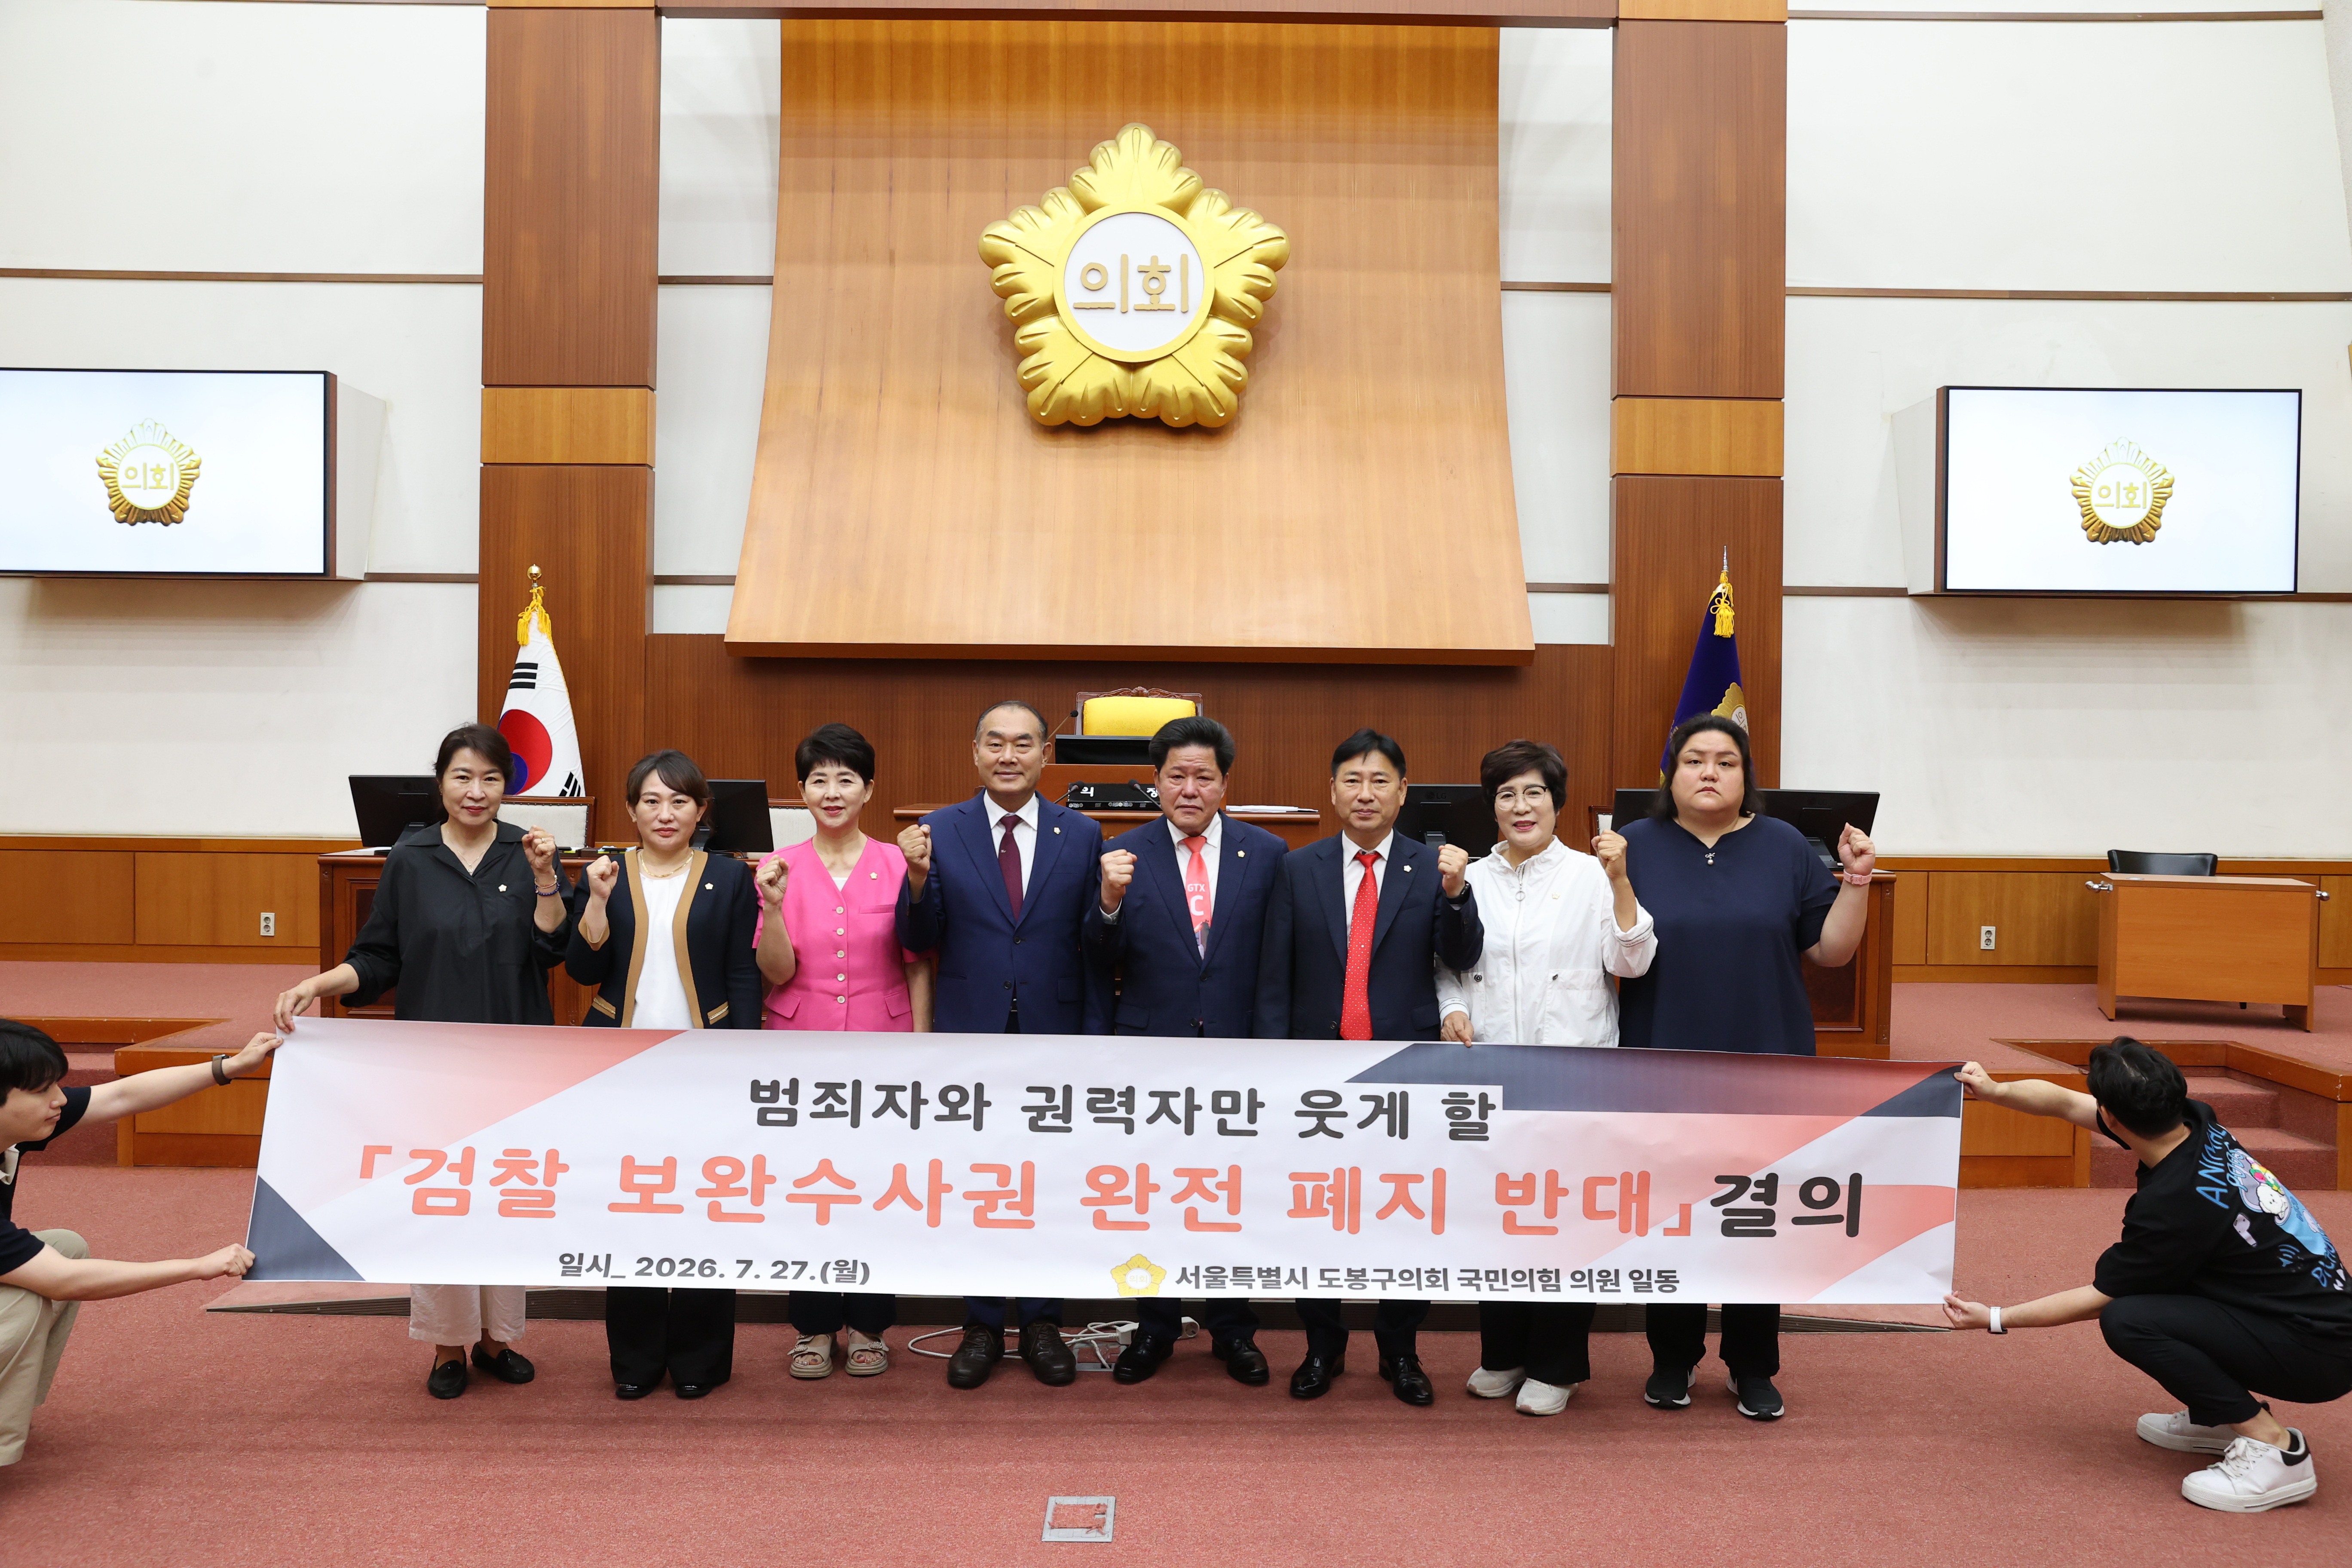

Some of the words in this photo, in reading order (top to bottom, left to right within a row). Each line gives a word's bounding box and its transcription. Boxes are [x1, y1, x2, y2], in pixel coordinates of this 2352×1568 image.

[1073, 254, 1188, 313] 의회
[121, 462, 174, 490] 의회
[2094, 481, 2147, 508] 의회
[1187, 883, 1206, 892] GTX
[1190, 894, 1204, 916] C
[750, 1078, 992, 1132] 범죄자와
[1021, 1084, 1265, 1136] 권력자만
[1294, 1088, 1409, 1140] 웃게
[1441, 1092, 1496, 1141] 할
[2196, 1121, 2230, 1210] ANIMAL
[360, 1145, 569, 1218] 「검찰
[608, 1155, 1035, 1229] 보완수사권
[1081, 1163, 1242, 1233] 완전
[1288, 1167, 1446, 1235] 폐지
[559, 1253, 626, 1279] 일시_
[634, 1257, 725, 1278] 2026.
[736, 1259, 760, 1279] 7.
[770, 1259, 870, 1285] 27.(월)
[1129, 1275, 1147, 1283] 의회
[1176, 1265, 1308, 1289] 서울특별시
[1318, 1268, 1449, 1291] 도봉구의회
[1457, 1268, 1561, 1292] 국민의힘
[1570, 1268, 1621, 1293] 의원
[1628, 1269, 1680, 1293] 일동
